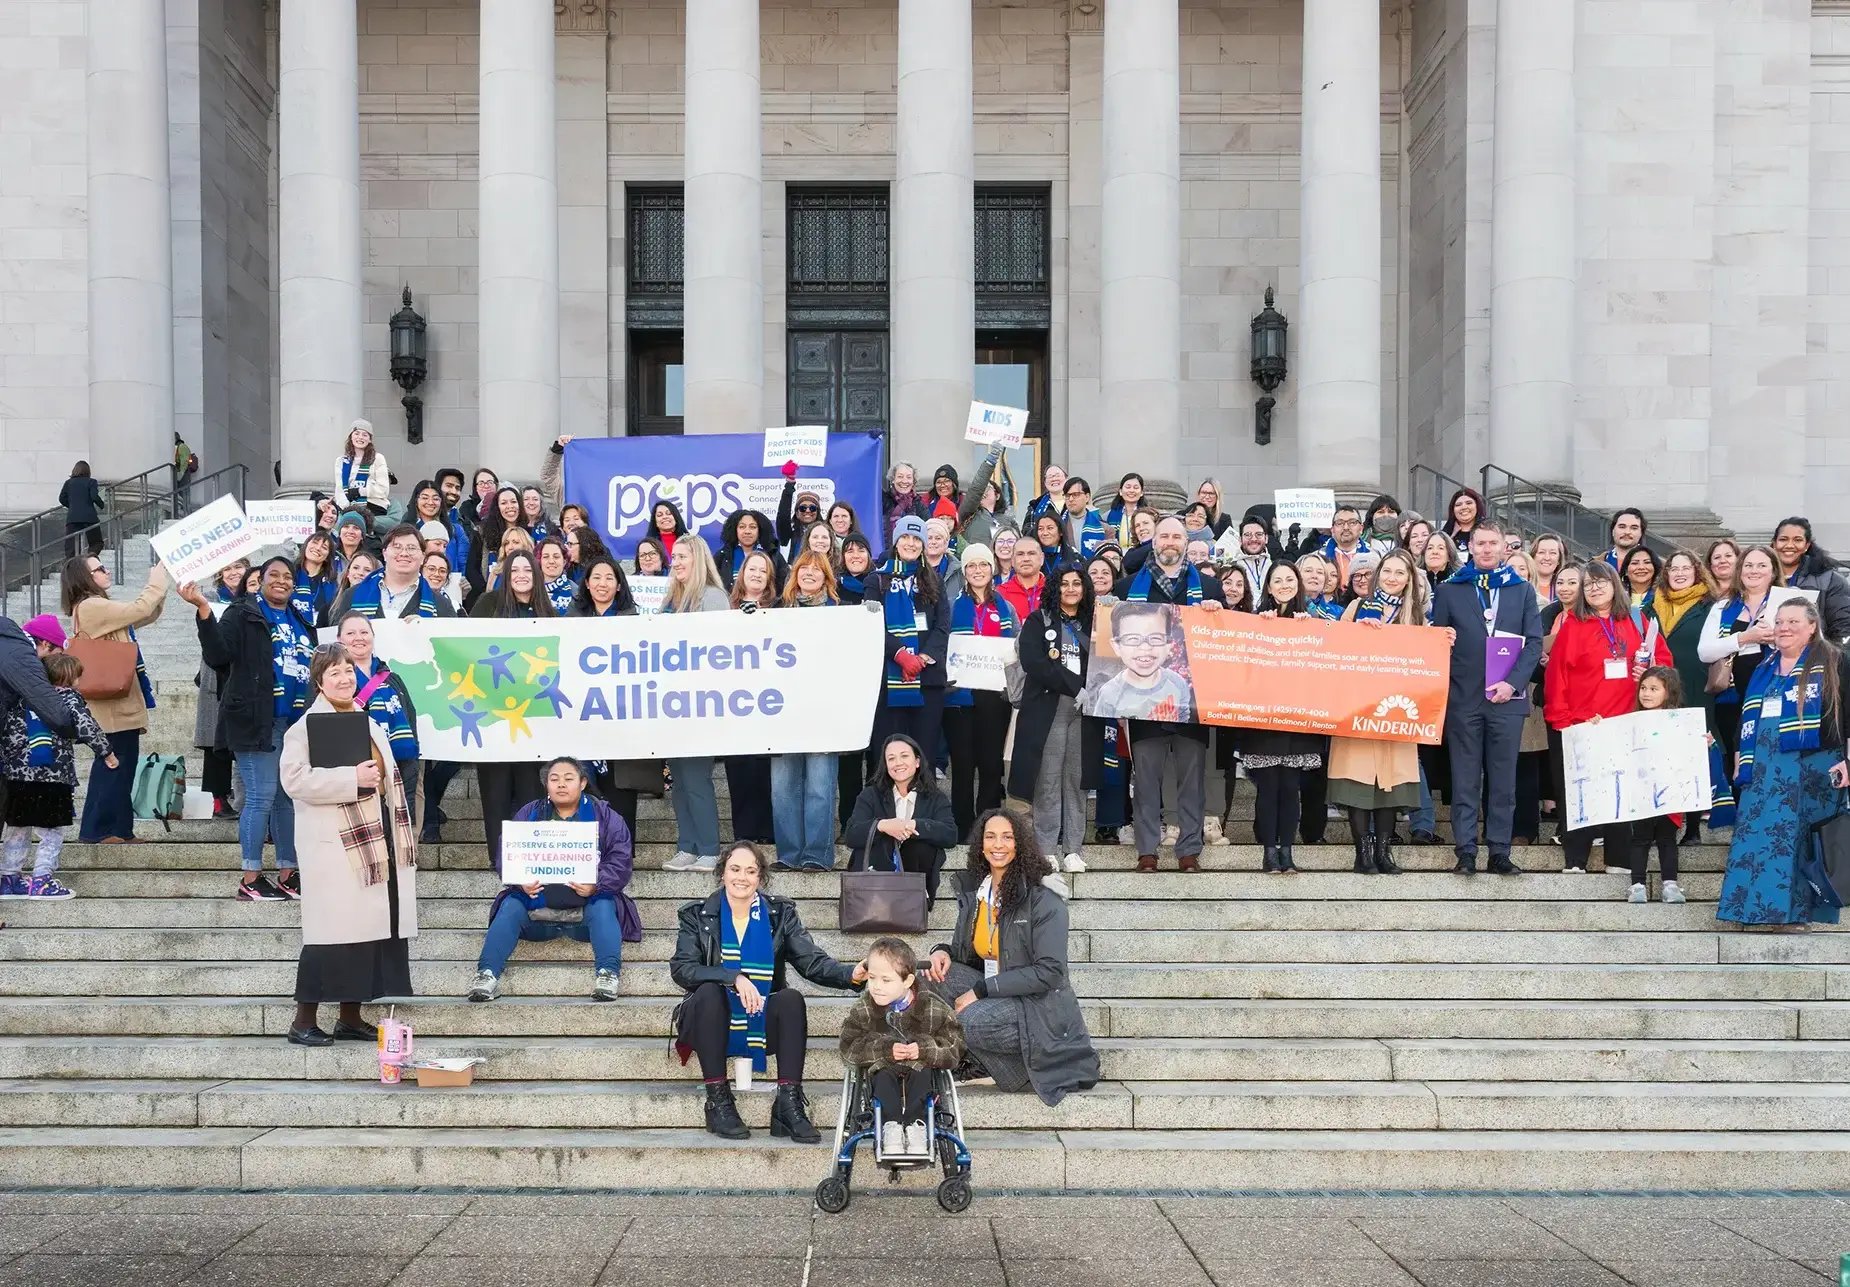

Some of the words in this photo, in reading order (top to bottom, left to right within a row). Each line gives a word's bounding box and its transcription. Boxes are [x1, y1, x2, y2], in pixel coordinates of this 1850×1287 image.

[983, 409, 1012, 427] KIDS
[969, 427, 987, 437] TECH
[988, 431, 1020, 443] PFITS
[767, 439, 802, 448] PROTECT
[803, 439, 823, 447] KIDS
[767, 448, 796, 458] ONLINE
[796, 447, 822, 457] NOW!
[1279, 501, 1314, 509] PROTECT
[1315, 501, 1332, 509] KIDS
[249, 514, 290, 523] FAMILIES
[291, 515, 313, 523] NEED
[1280, 511, 1310, 519] ONLINE
[254, 526, 284, 537] CHILD
[286, 526, 314, 536] CARE
[166, 537, 204, 565] KIDS
[202, 517, 243, 546] NEED
[176, 556, 206, 577] EARLY
[204, 532, 252, 562] LEARNING
[1191, 624, 1211, 634] Kids
[1211, 628, 1236, 638] grow
[1236, 630, 1254, 640] and
[1255, 632, 1287, 646] change
[1287, 635, 1323, 648] quickly!
[578, 637, 797, 675] Children's
[1192, 640, 1226, 650] Children
[1226, 643, 1235, 652] of
[1236, 643, 1246, 652] all
[1247, 644, 1274, 656] abilities
[1275, 649, 1291, 657] and
[1292, 649, 1311, 658] their
[1311, 651, 1341, 661] families
[1341, 654, 1359, 662] soar
[1369, 655, 1408, 666] Kindering
[1408, 657, 1425, 665] with
[983, 663, 1003, 671] KIDS
[1193, 652, 1208, 660] our
[1208, 652, 1243, 662] pediatric
[1280, 659, 1306, 669] family
[1339, 663, 1355, 671] and
[1355, 664, 1376, 674] early
[1376, 665, 1409, 676] learning
[579, 680, 784, 721] Alliance
[1217, 700, 1265, 713] Kindering.org
[1207, 710, 1233, 720] Bothell
[1237, 714, 1268, 723] Bellevue
[1272, 716, 1307, 727] Redmond
[1311, 720, 1337, 730] Renton
[1352, 715, 1436, 737] KINDERING
[506, 841, 547, 849] PRESERVE
[548, 841, 556, 849] &
[507, 852, 540, 862] EARLY
[541, 852, 592, 862] LEARNING
[525, 866, 575, 876] FUNDING!
